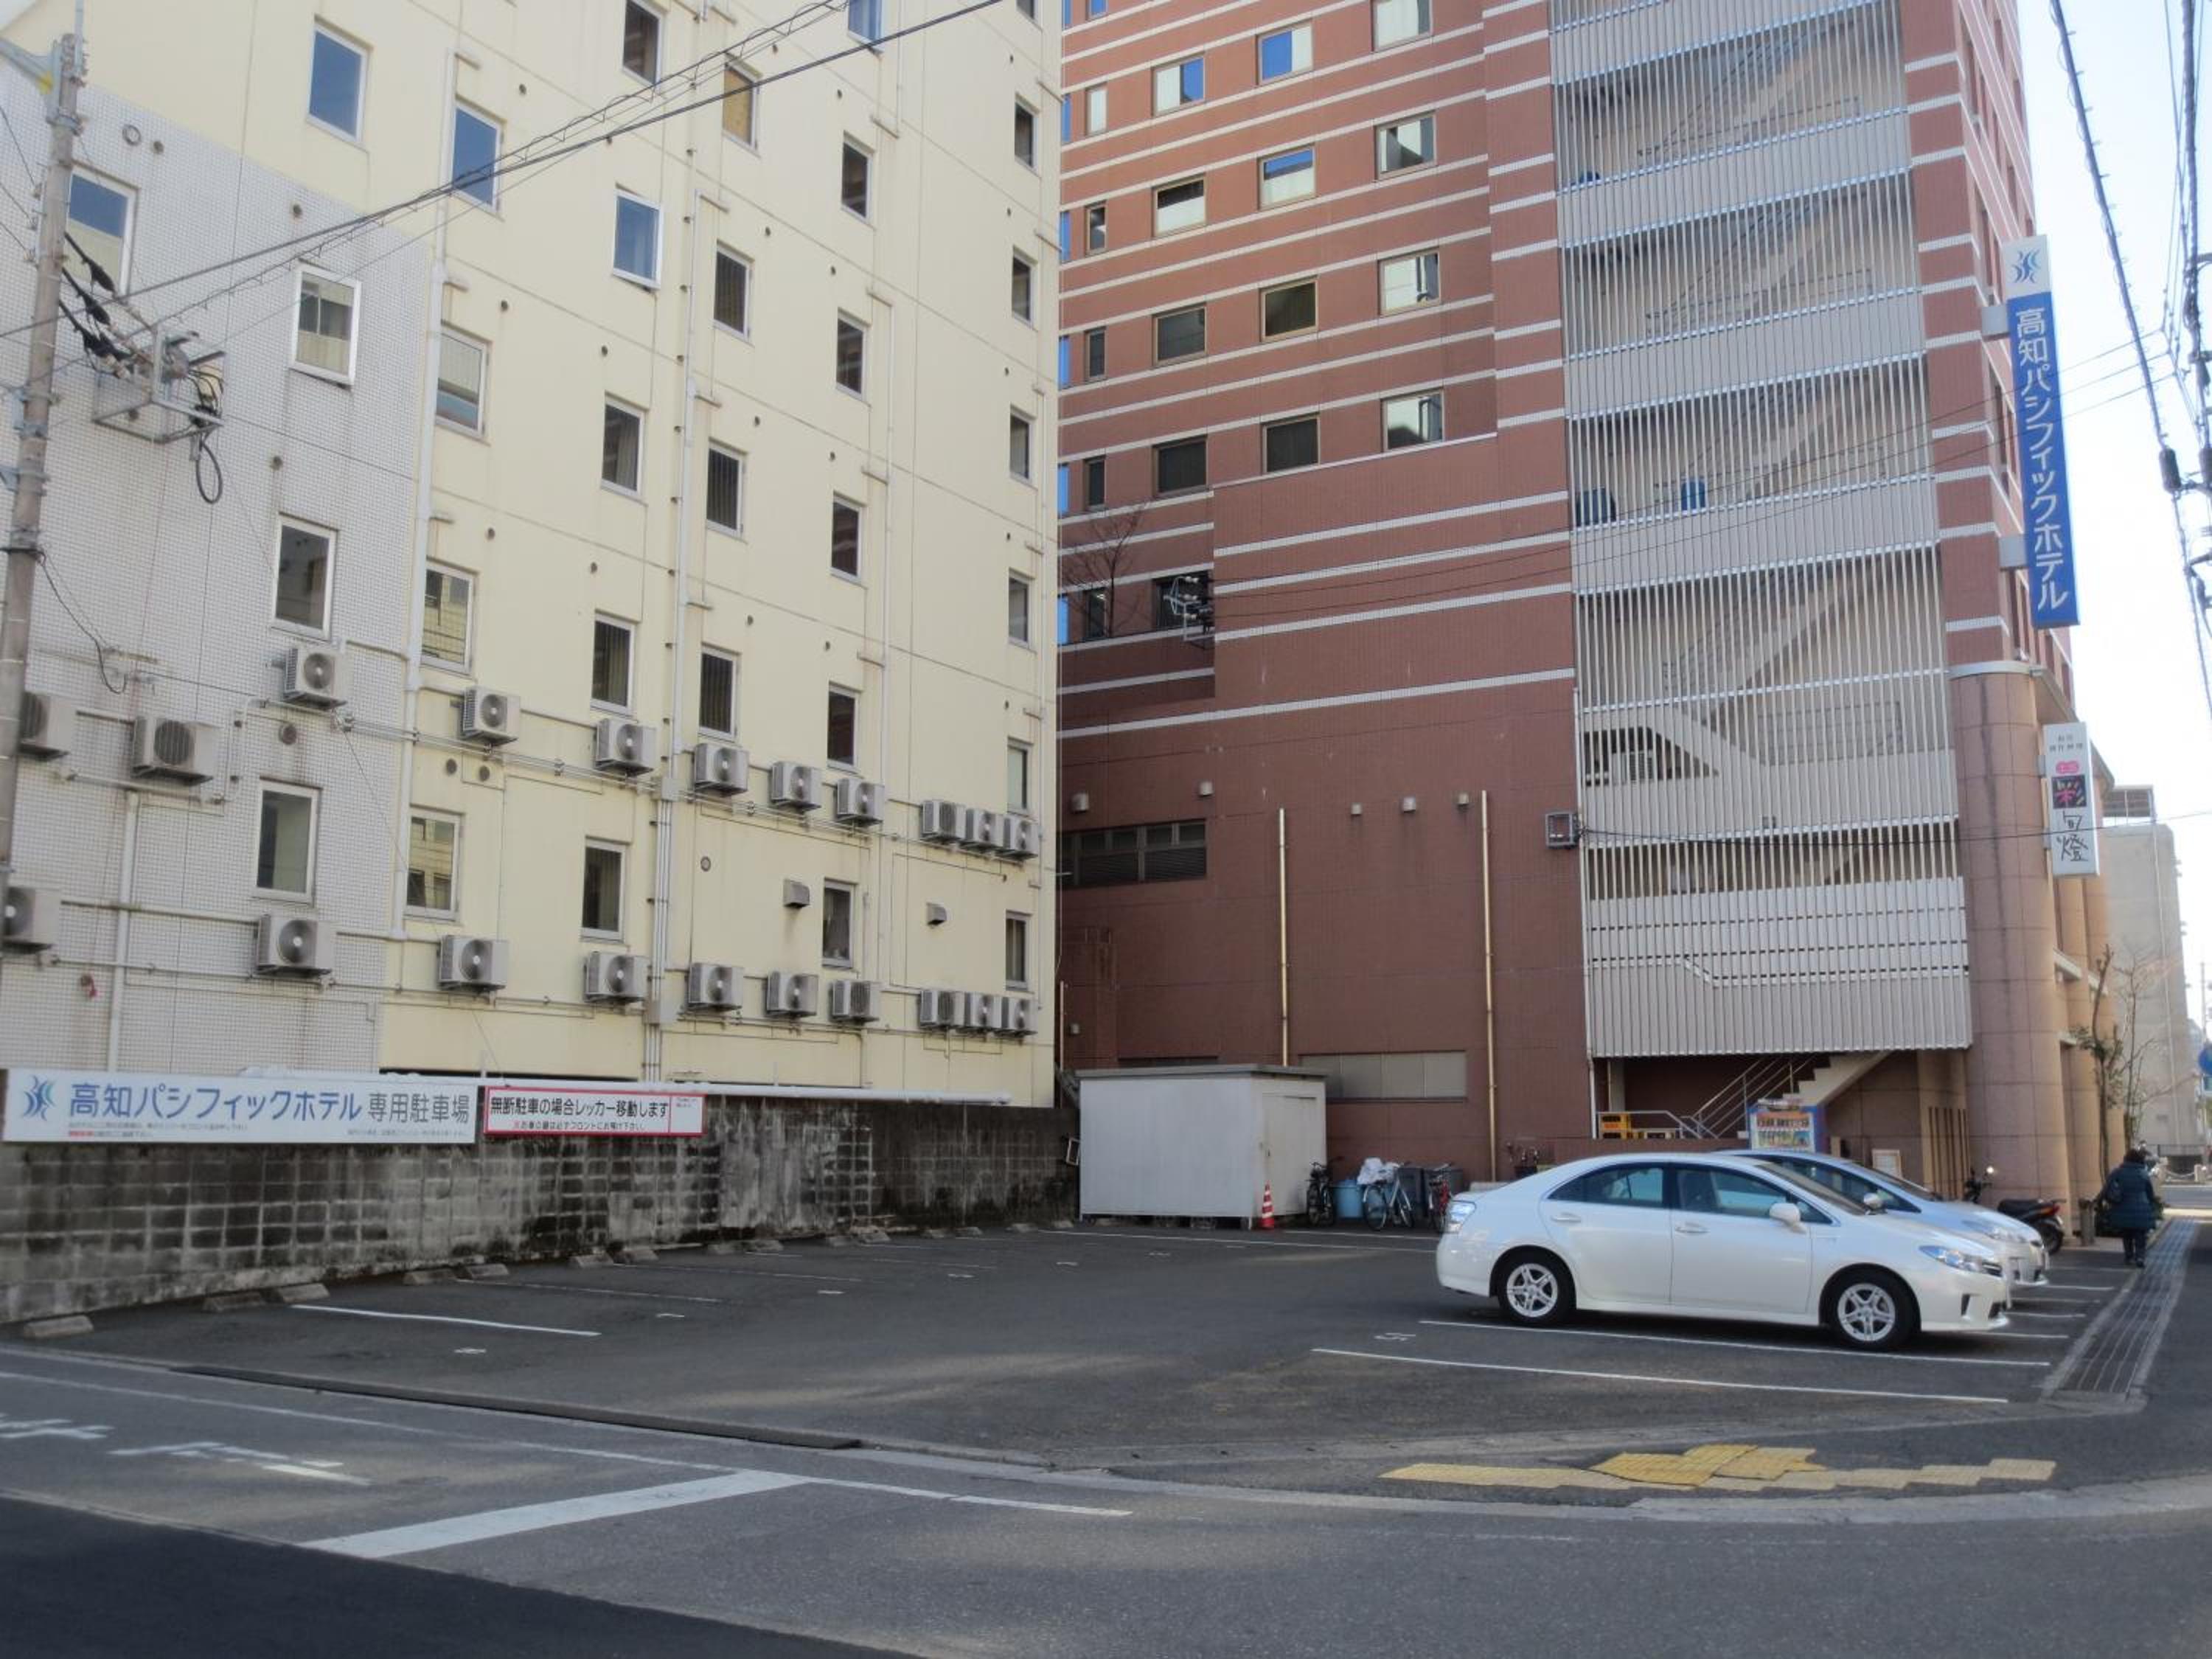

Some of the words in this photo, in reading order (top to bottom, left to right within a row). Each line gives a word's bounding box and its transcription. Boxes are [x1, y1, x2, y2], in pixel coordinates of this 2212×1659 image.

[2015, 307, 2069, 611] 高知パシフィックホテル
[69, 1082, 363, 1121] 高知パシフィックホテル
[368, 1093, 470, 1124] 専用駐車場
[490, 1096, 668, 1118] 無断駐車の場合レッカー移動します
